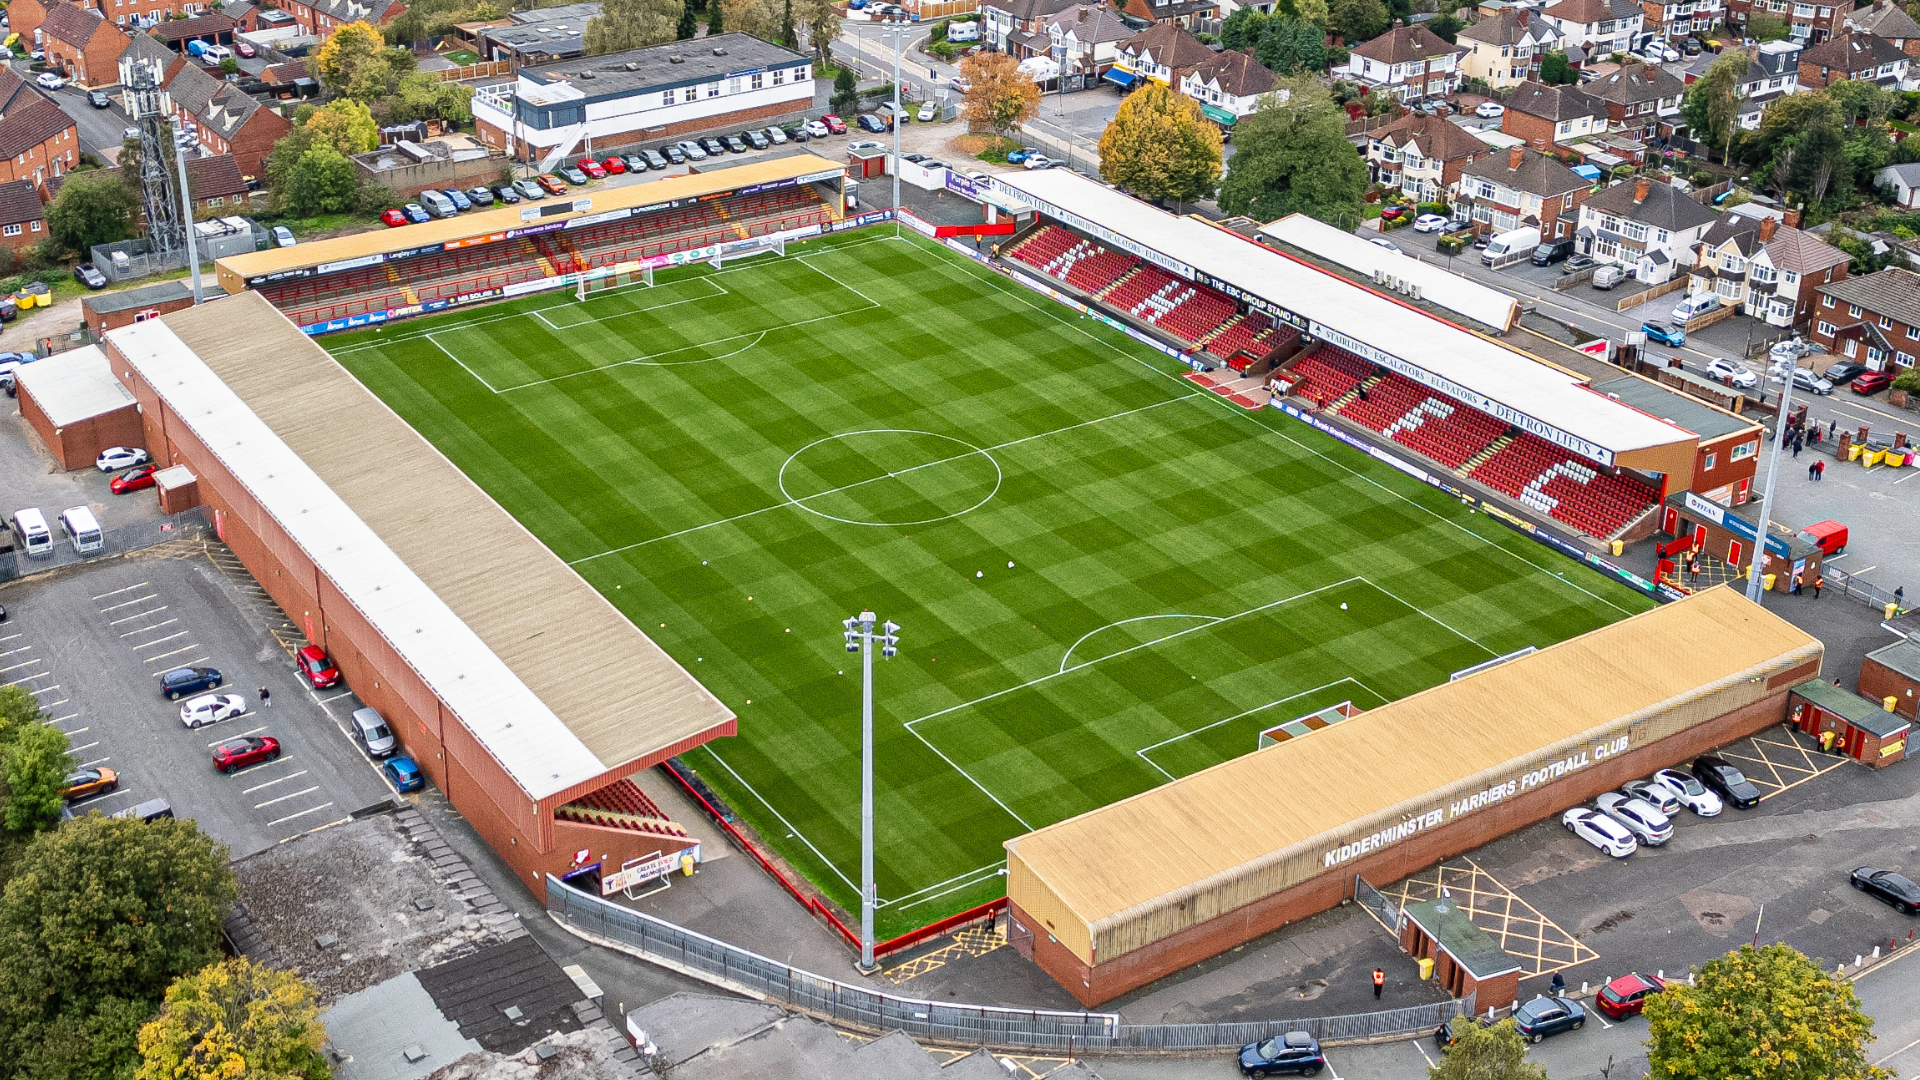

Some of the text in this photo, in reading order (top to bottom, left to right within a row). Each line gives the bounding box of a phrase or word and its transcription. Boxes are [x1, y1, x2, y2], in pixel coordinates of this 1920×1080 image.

[999, 183, 1032, 209] DELTRON
[1033, 197, 1056, 217] LIFTS
[1066, 214, 1181, 271] STAIRLIFTS ESCALATORS ELEVATORS
[469, 290, 493, 299] SOLAR
[1211, 278, 1226, 292] THE
[1226, 286, 1241, 298] EBC
[1241, 292, 1267, 310] GROUP
[1267, 303, 1291, 321] STAND
[1326, 330, 1478, 404] STAIRLIFTS ESCALATORS ELEVATORS
[1496, 404, 1591, 455] DELTRON LIFTS
[1324, 735, 1629, 868] KIDDERMINSTER HARRIERS FOOTBALL CLUB
